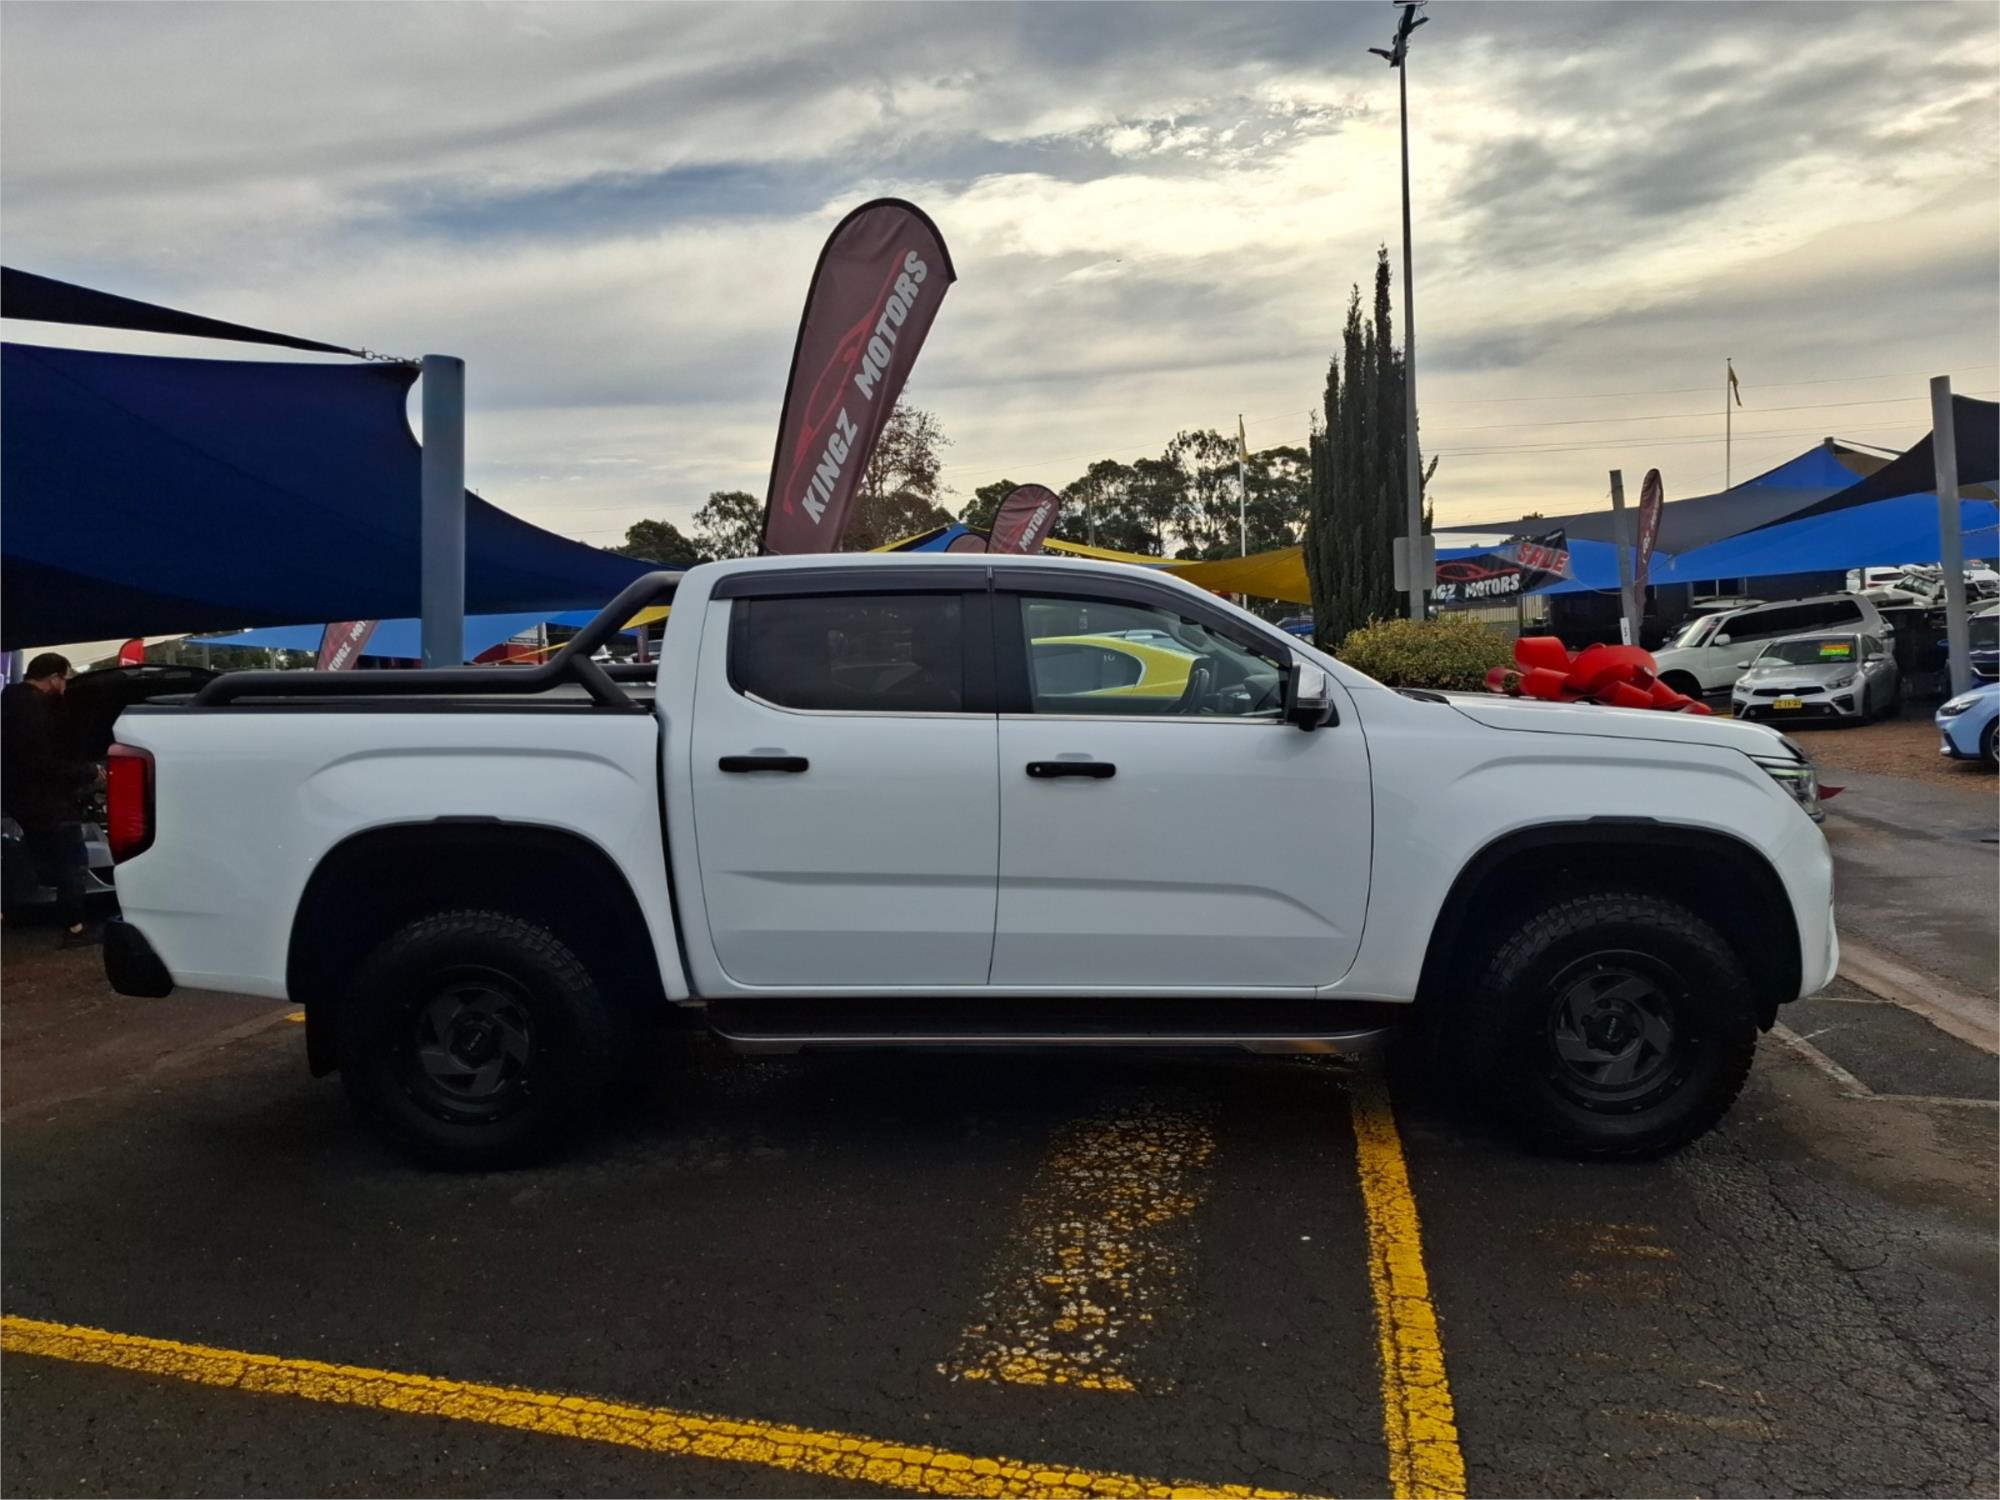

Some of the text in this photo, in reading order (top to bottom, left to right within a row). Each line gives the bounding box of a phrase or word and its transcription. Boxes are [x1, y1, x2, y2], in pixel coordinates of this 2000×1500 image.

[802, 251, 928, 524] KINGZ MOTORS
[1019, 501, 1051, 551] MOTORS
[1518, 543, 1569, 573] SALE
[1465, 573, 1520, 598] MOTORS
